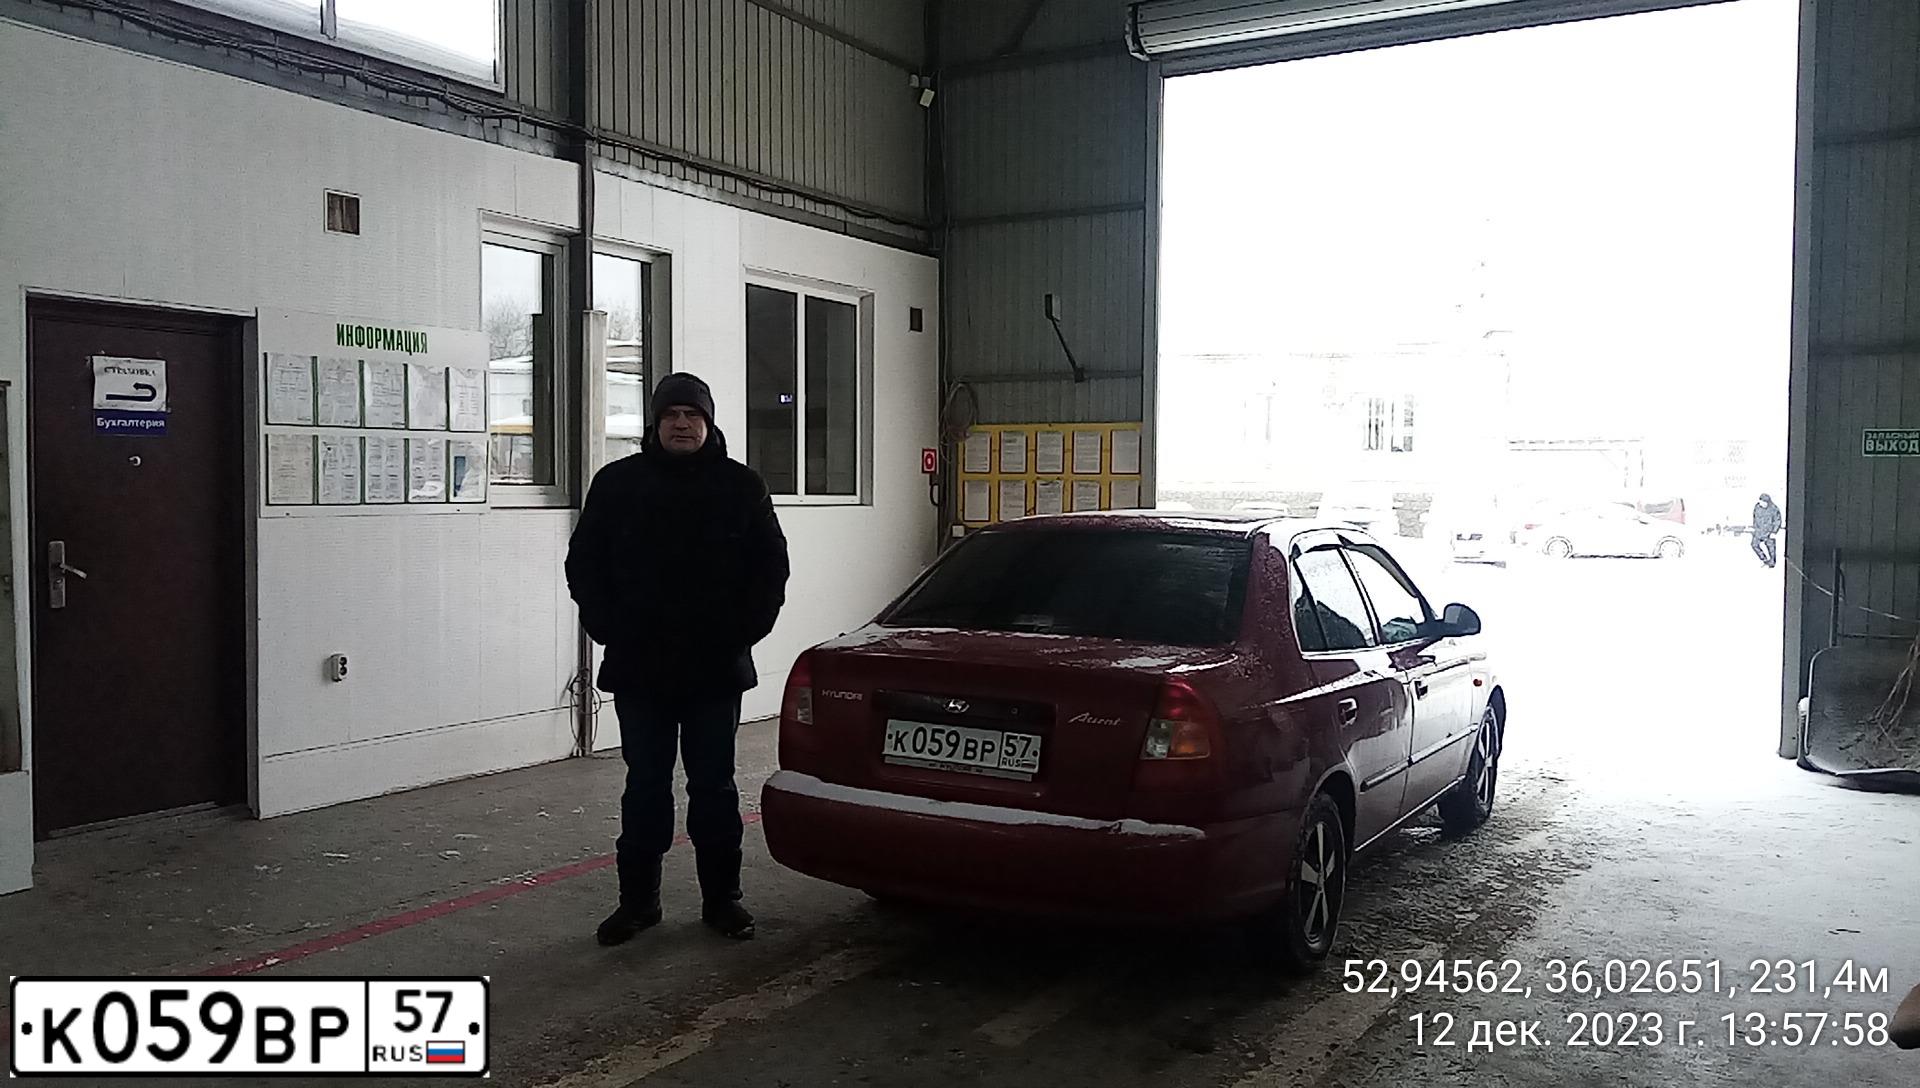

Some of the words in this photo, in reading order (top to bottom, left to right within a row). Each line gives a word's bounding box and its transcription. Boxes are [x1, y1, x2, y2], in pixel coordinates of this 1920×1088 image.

[336, 323, 428, 356] ИНФОРМАЦИЯ
[96, 417, 166, 430] Бухгалтерия
[1865, 440, 1919, 453] ВЫХОД
[893, 726, 996, 762] К059ВР
[1003, 735, 1033, 759] 57
[1001, 757, 1021, 768] RUS
